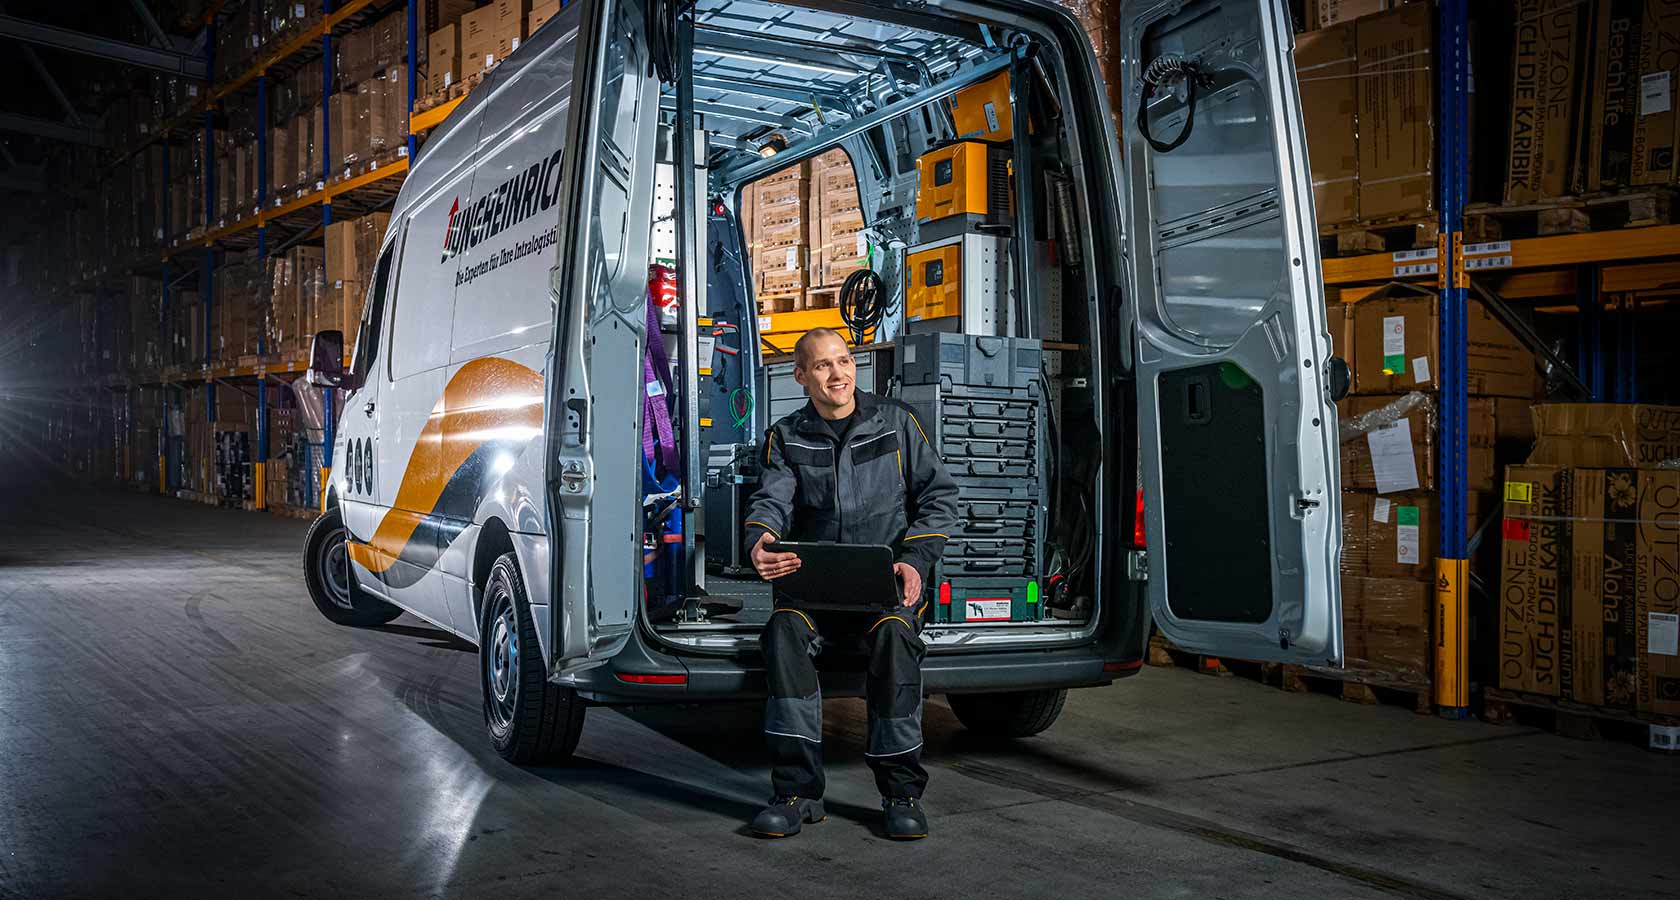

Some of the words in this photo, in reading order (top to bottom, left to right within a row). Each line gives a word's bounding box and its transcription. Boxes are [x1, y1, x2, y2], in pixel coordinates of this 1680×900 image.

[1516, 63, 1536, 99] DIE
[1604, 17, 1631, 127] BeachLife
[1511, 106, 1534, 191] KARIBIK
[464, 261, 489, 285] Experten
[489, 254, 499, 272] für
[499, 247, 513, 267] Ihre
[514, 226, 557, 261] Intralogisti
[1503, 549, 1526, 680] OUTZONE
[1538, 576, 1555, 615] DIE
[1603, 553, 1624, 623] Aloha
[1536, 622, 1554, 684] SUCH
